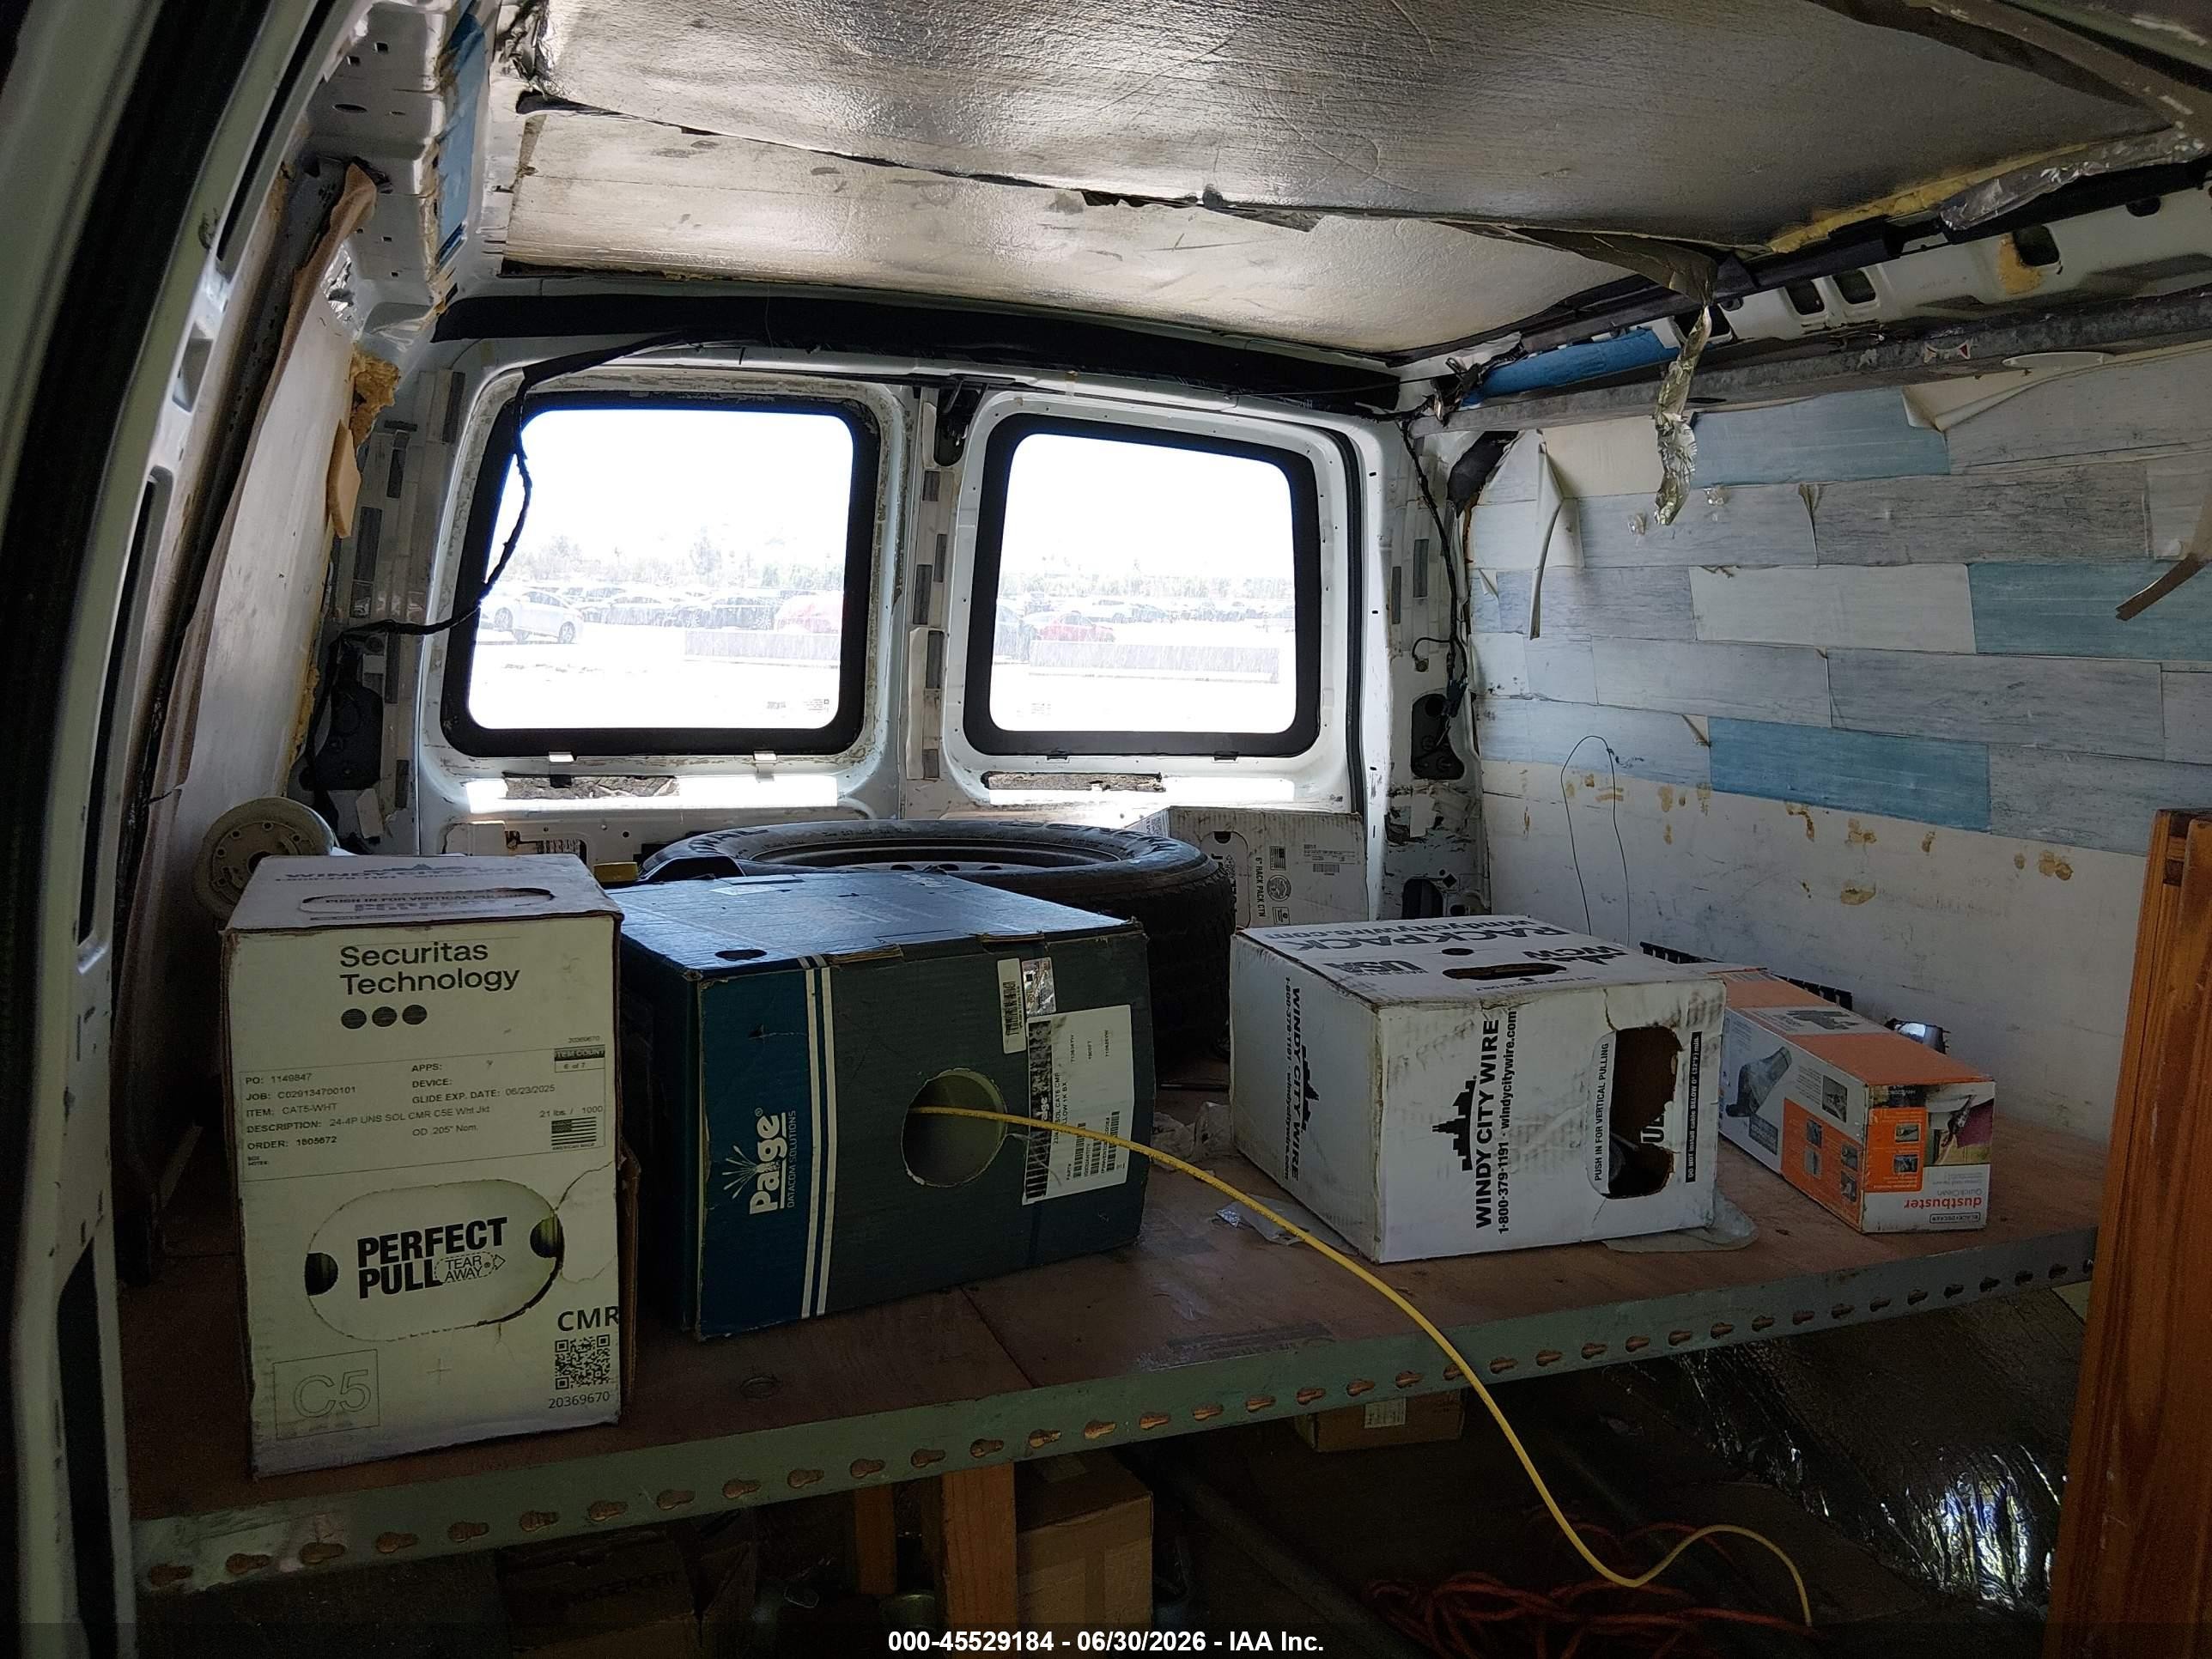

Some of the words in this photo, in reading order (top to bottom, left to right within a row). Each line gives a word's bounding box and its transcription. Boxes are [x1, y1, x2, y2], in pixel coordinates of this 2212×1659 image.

[1257, 904, 1266, 917] CTN
[1264, 918, 1534, 941] windycitywire.com
[1283, 929, 1570, 951] RACKPACK
[340, 941, 488, 968] Securitas
[1323, 960, 1423, 973] USA
[339, 968, 520, 995] Technology
[1291, 988, 1302, 1068] WINDY
[1480, 1019, 1499, 1085] WIRE
[1598, 1042, 1609, 1085] PULLING
[411, 1063, 443, 1073] APPS:
[1499, 1009, 1517, 1130] windycitywire.com
[245, 1076, 264, 1085] PO:
[411, 1078, 453, 1089] DEVICE:
[246, 1092, 271, 1101] JOB:
[411, 1093, 443, 1104] GLIDE
[445, 1091, 468, 1102] EXP.
[470, 1090, 501, 1100] DATE:
[1293, 1065, 1302, 1120] CITY
[246, 1108, 275, 1118] ITEM:
[282, 1103, 338, 1115] CAT5-WHT
[539, 1109, 550, 1119] 21
[581, 1105, 604, 1115] 1000
[1476, 1089, 1495, 1145] CITY
[1595, 1085, 1607, 1126] VERTICAL
[246, 1120, 322, 1133] DESCRIPTION:
[360, 1115, 383, 1124] UNS
[384, 1113, 406, 1121] SOL
[408, 1110, 432, 1120] CMR
[411, 1127, 428, 1137] OD
[246, 1139, 289, 1151] ORDER:
[788, 1109, 798, 1164] SOLUTIONS
[1595, 1126, 1604, 1144] FOR
[1291, 1121, 1302, 1182] WIRE
[1595, 1145, 1603, 1156] IN
[1594, 1157, 1603, 1182] PUSH
[787, 1164, 797, 1210] DATACOM
[1475, 1149, 1492, 1229] WINDY
[1498, 1141, 1510, 1235] 1-800-379-1191
[1904, 1196, 1983, 1210] dustbuster
[356, 1216, 508, 1269] PERFECT
[446, 1255, 483, 1269] TEAR
[358, 1259, 444, 1299] PULL
[445, 1266, 484, 1282] AWAY
[556, 1305, 620, 1333] CMR
[293, 1368, 373, 1419] C5
[548, 1390, 611, 1410] 20369670
